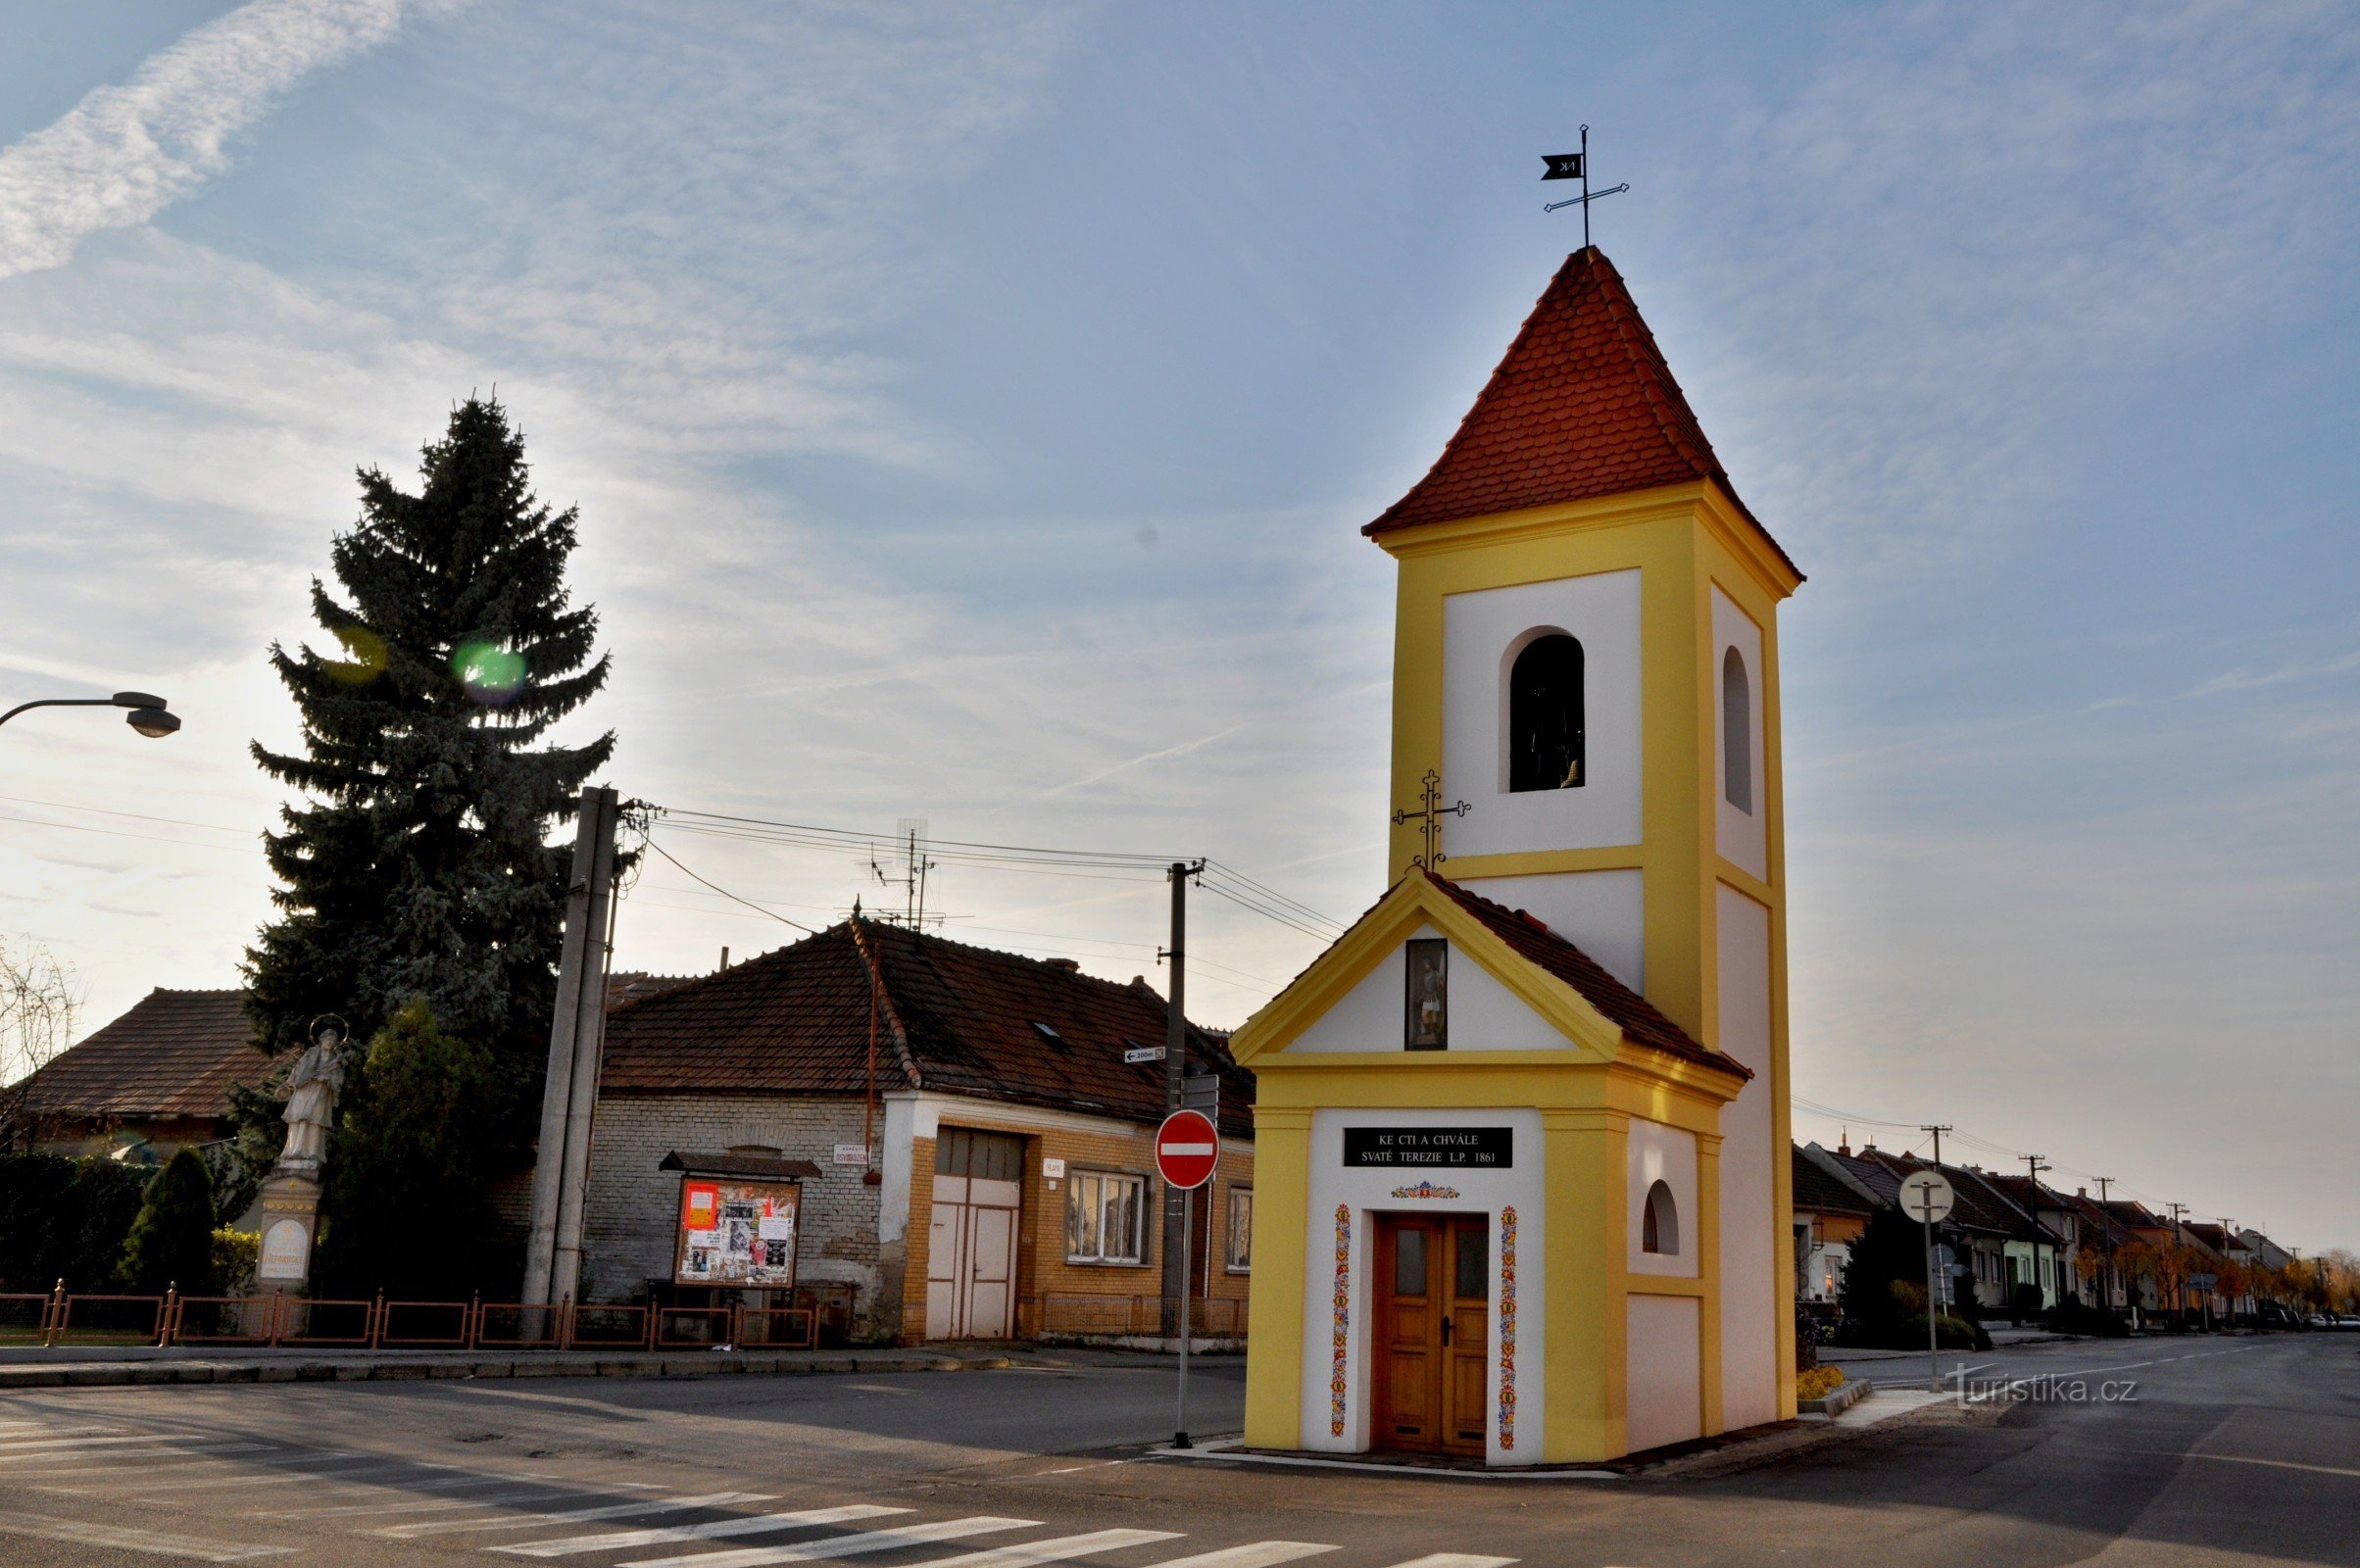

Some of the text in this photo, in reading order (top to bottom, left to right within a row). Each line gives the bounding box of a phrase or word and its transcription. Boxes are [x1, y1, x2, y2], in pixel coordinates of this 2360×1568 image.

[1379, 1133, 1479, 1145] KE CTI A CHVÁLE
[1361, 1150, 1496, 1162] SVATÉ TEREZIE L.P. 1861
